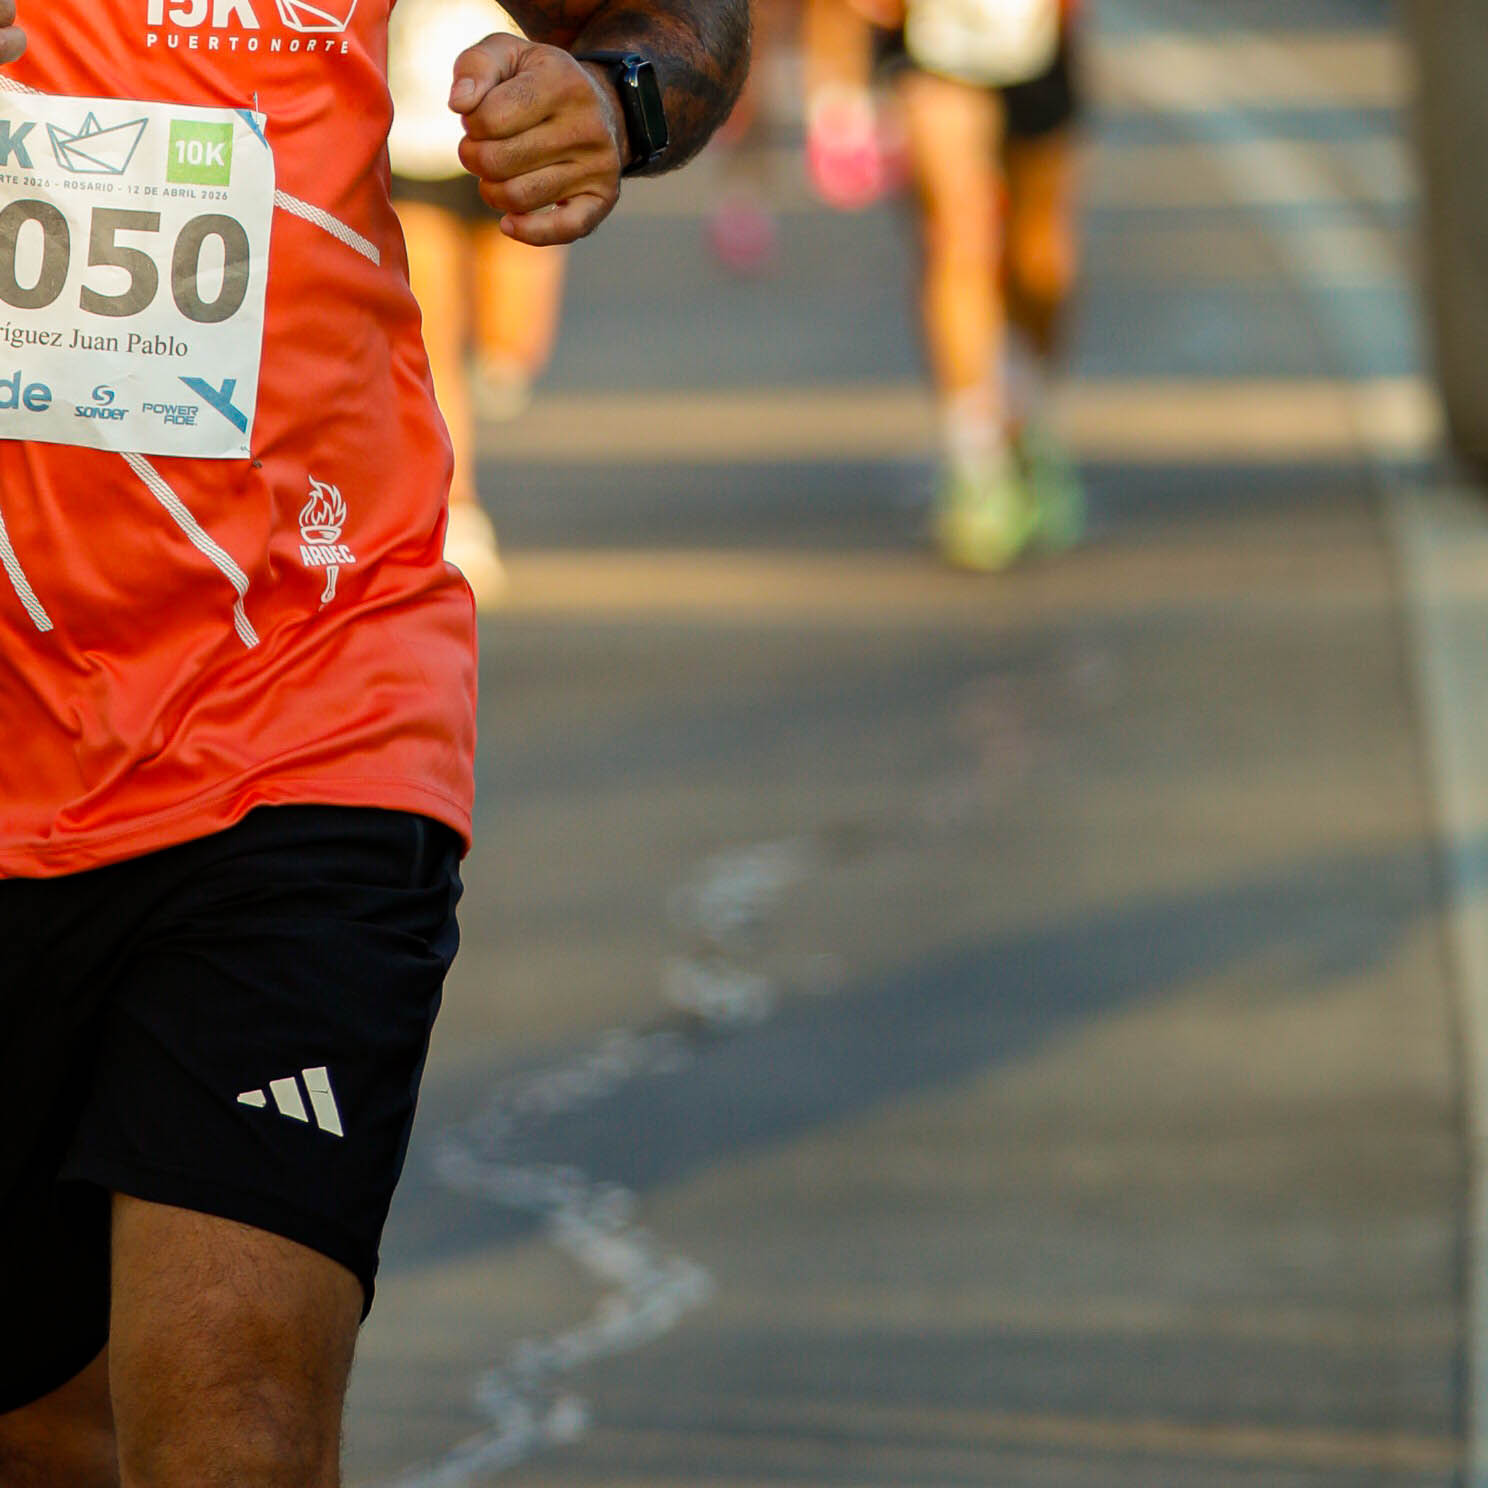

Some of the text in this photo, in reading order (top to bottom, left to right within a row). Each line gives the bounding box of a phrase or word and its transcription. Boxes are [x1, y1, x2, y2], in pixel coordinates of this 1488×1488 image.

[175, 139, 225, 168] 10K
[63, 180, 113, 193] ROSARIO
[128, 185, 139, 195] 12
[144, 186, 159, 196] DE
[162, 188, 197, 199] ABRIL
[201, 190, 228, 201] 2026
[69, 327, 119, 353] Juan
[127, 332, 189, 357] Pablo
[142, 402, 199, 416] POWER
[299, 544, 357, 567] ARDEC
